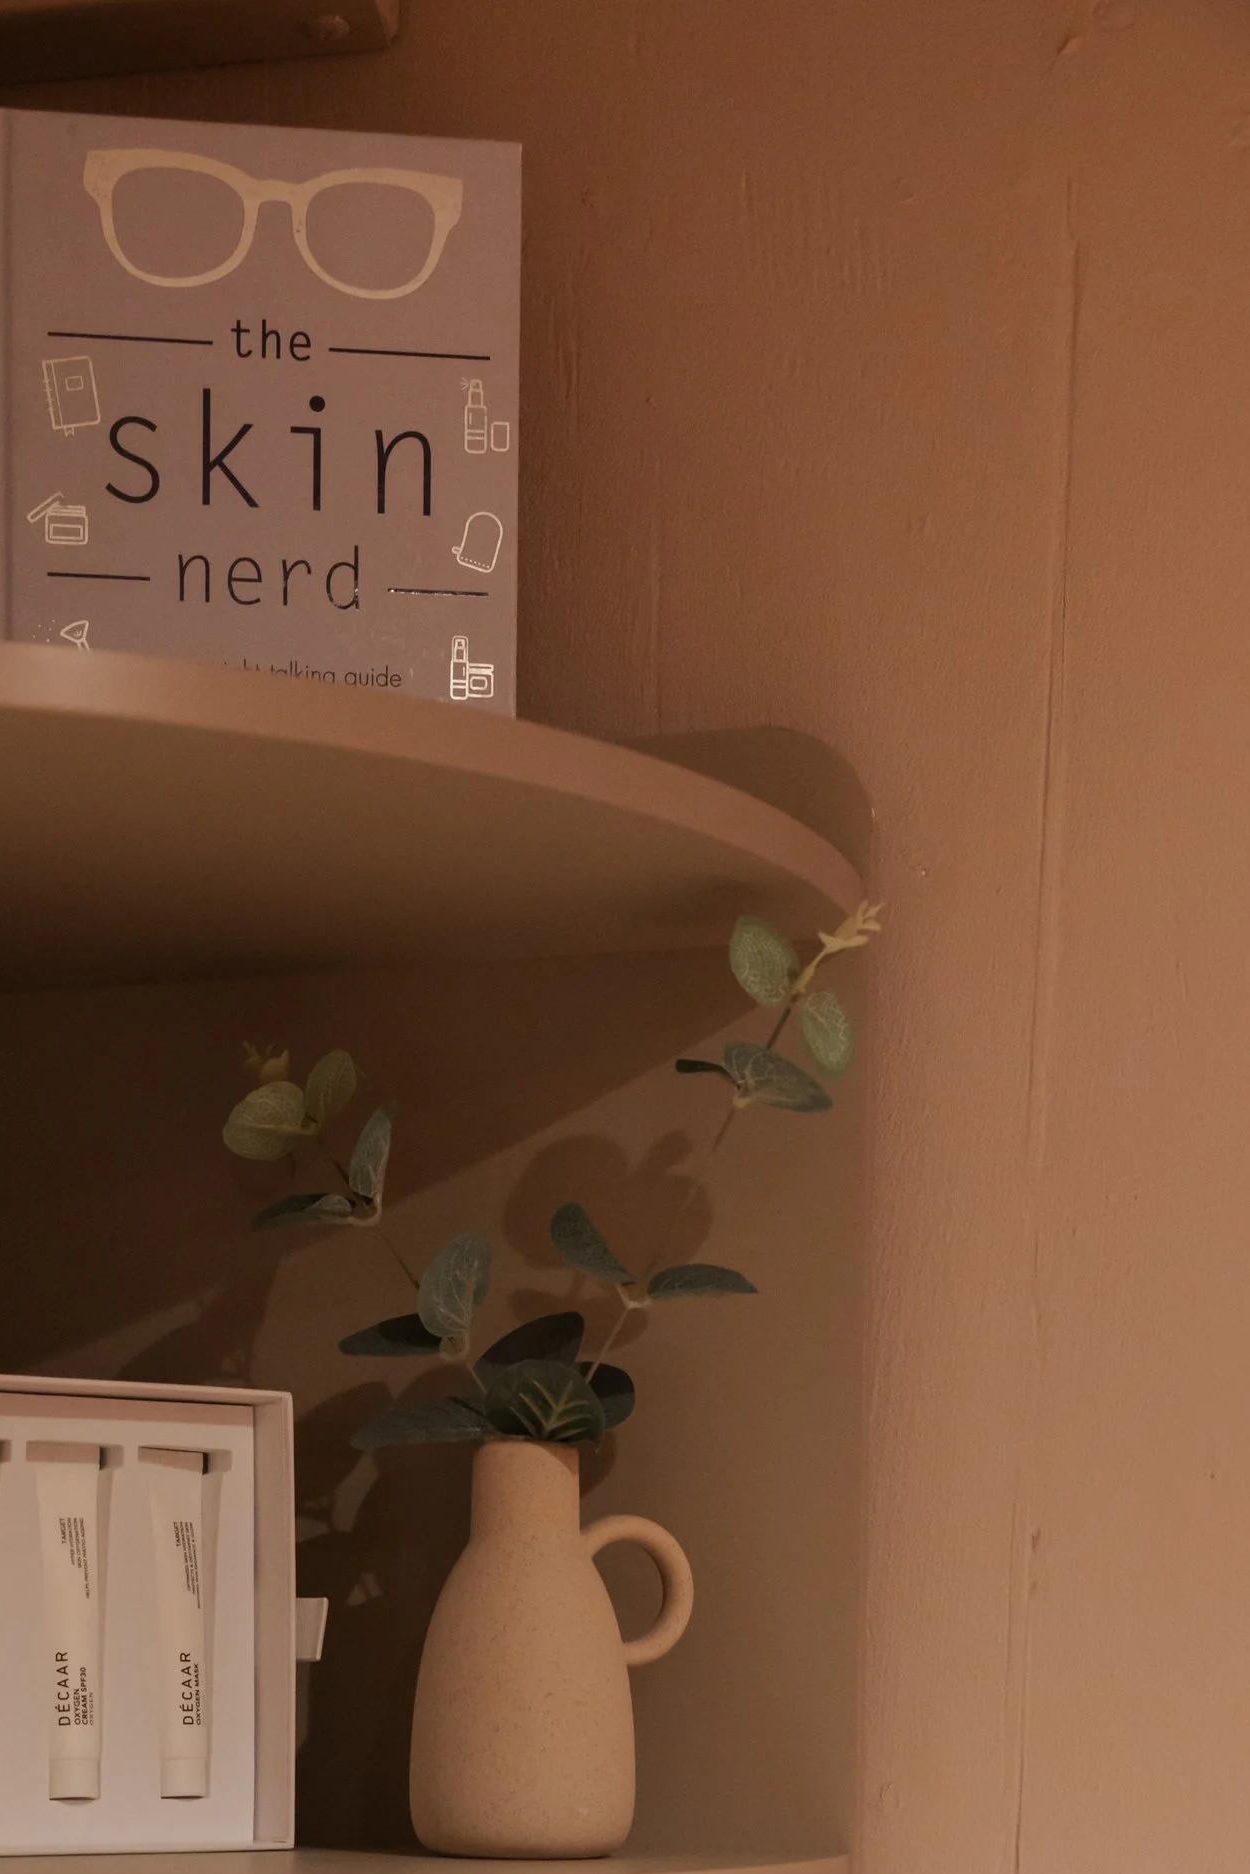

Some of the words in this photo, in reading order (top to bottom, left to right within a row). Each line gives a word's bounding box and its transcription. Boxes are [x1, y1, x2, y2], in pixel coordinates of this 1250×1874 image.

[231, 319, 312, 361] the
[105, 387, 432, 516] skin
[177, 544, 360, 610] nerd
[344, 664, 402, 688] guide
[59, 1517, 67, 1544] TARGET
[173, 1521, 181, 1548] TARGET
[55, 1651, 70, 1726] DÉCAAR
[73, 1688, 81, 1725] OXYGEN
[179, 1652, 194, 1725] DÉCAAR
